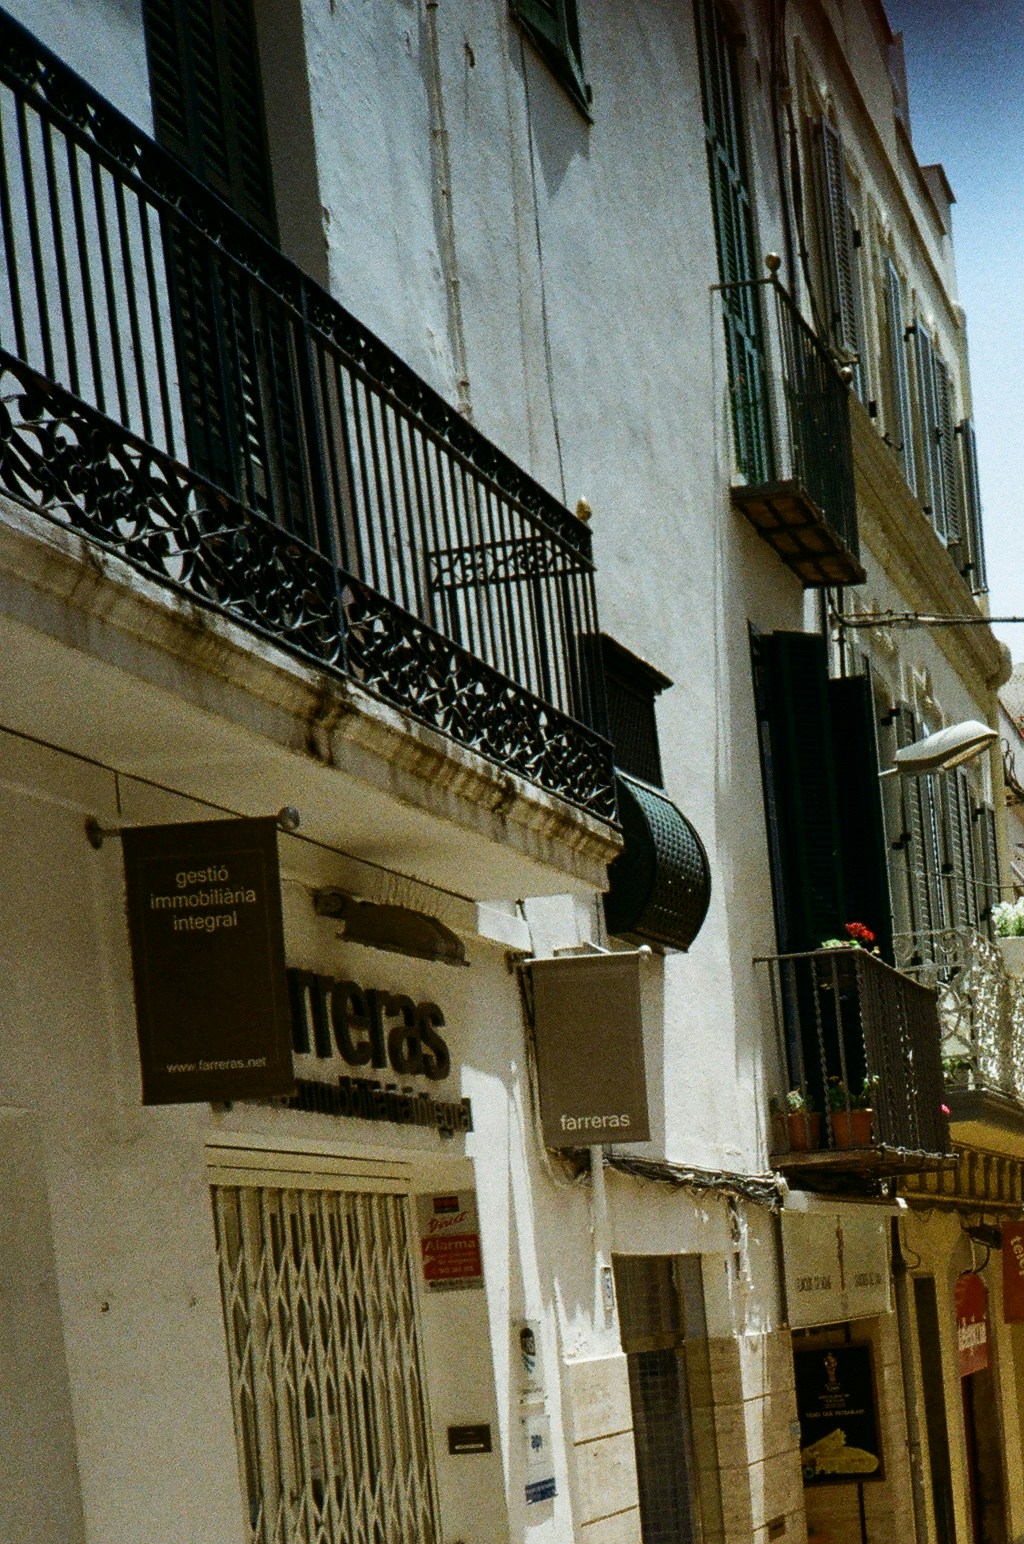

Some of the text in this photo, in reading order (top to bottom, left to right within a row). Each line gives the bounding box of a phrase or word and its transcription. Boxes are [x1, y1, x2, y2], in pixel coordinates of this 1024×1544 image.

[175, 864, 230, 889] gestió
[149, 886, 257, 909] immobiliària
[173, 910, 238, 933] integral
[287, 967, 450, 1081] rreras
[560, 1114, 630, 1131] farreras
[424, 1240, 477, 1252] Alarma
